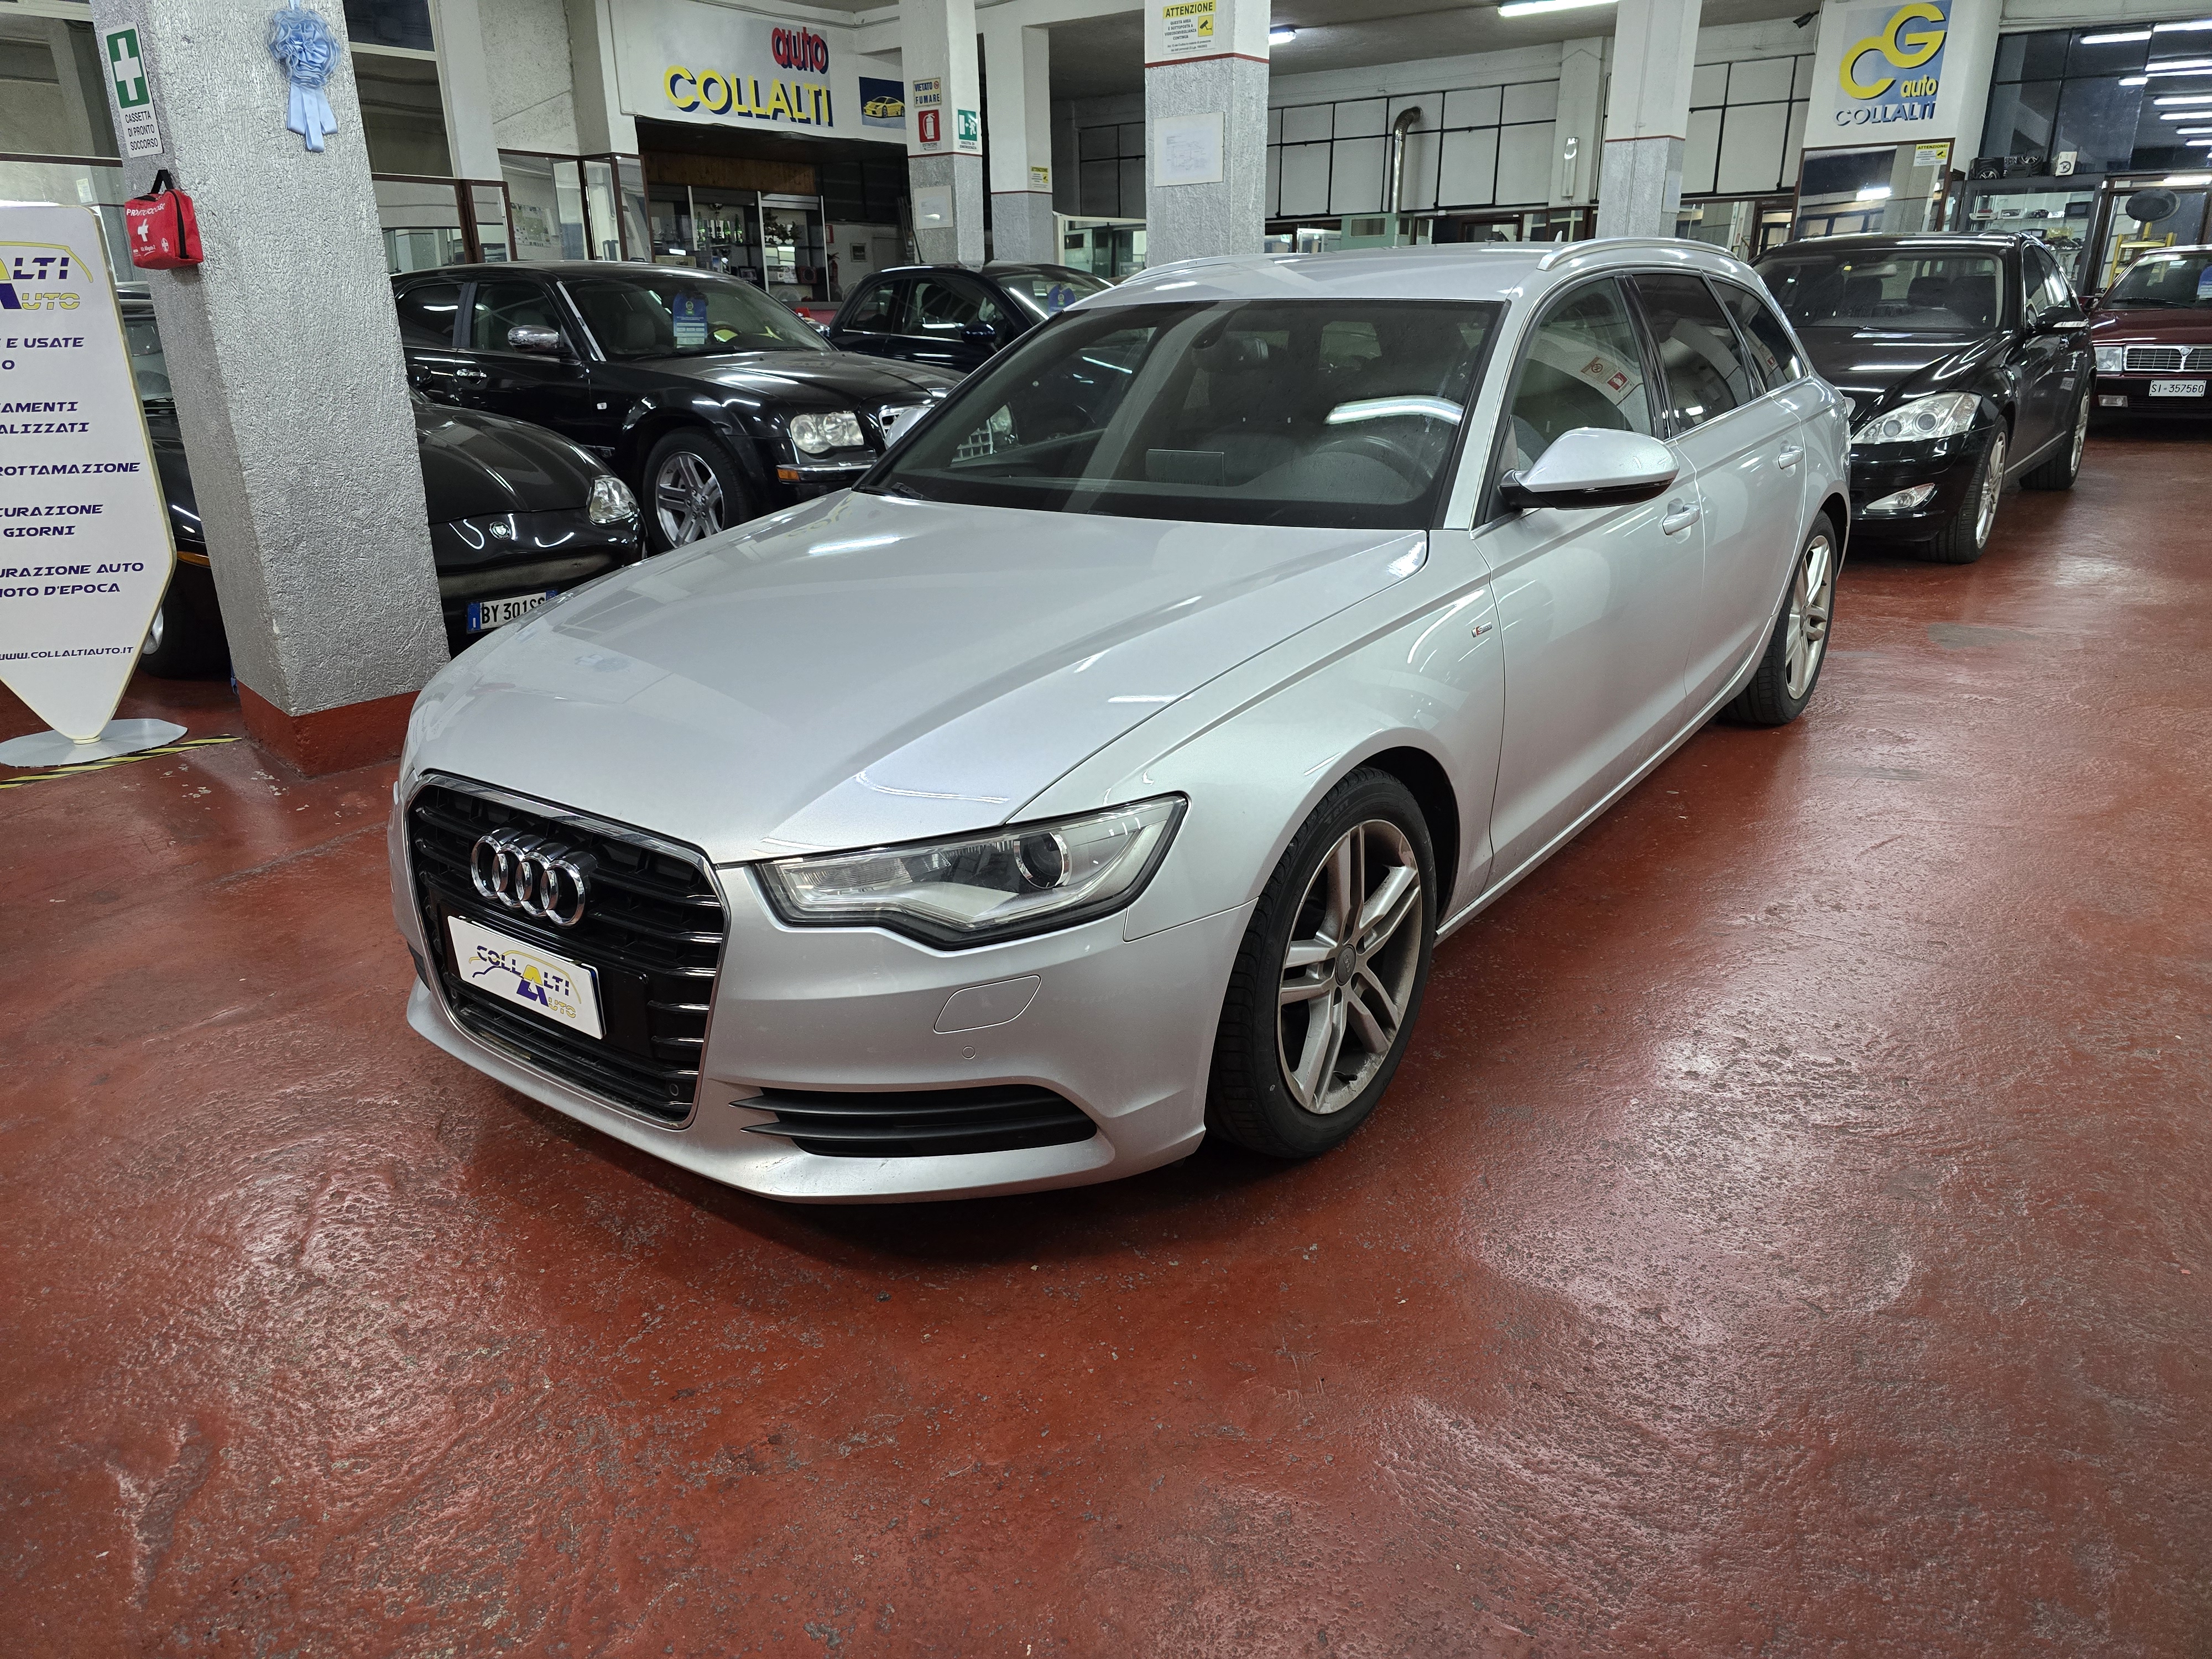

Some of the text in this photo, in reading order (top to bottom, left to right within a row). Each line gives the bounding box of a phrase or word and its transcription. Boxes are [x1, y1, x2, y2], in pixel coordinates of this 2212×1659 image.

[1165, 2, 1213, 17] ATTENZIONE
[771, 27, 827, 72] auto
[914, 82, 932, 92] VIETATO
[1900, 74, 1938, 98] auto
[664, 65, 832, 126] COLLALTI
[915, 93, 940, 104] FUMARE
[125, 111, 152, 123] CASSETTA
[1834, 101, 1936, 126] COLLALTI
[128, 124, 155, 137] DI PRONTO
[130, 138, 158, 150] SOCCORSO
[6, 337, 85, 348] E USATE
[2, 360, 15, 370] O
[2168, 384, 2204, 393] 357560
[0, 401, 79, 413] AMENTI
[0, 462, 140, 476] OTTAMAZIONE
[3, 525, 76, 537] GIORNI
[96, 562, 144, 573] AUTO
[0, 583, 121, 597] OTO D'EPOCA
[482, 605, 499, 624] BY
